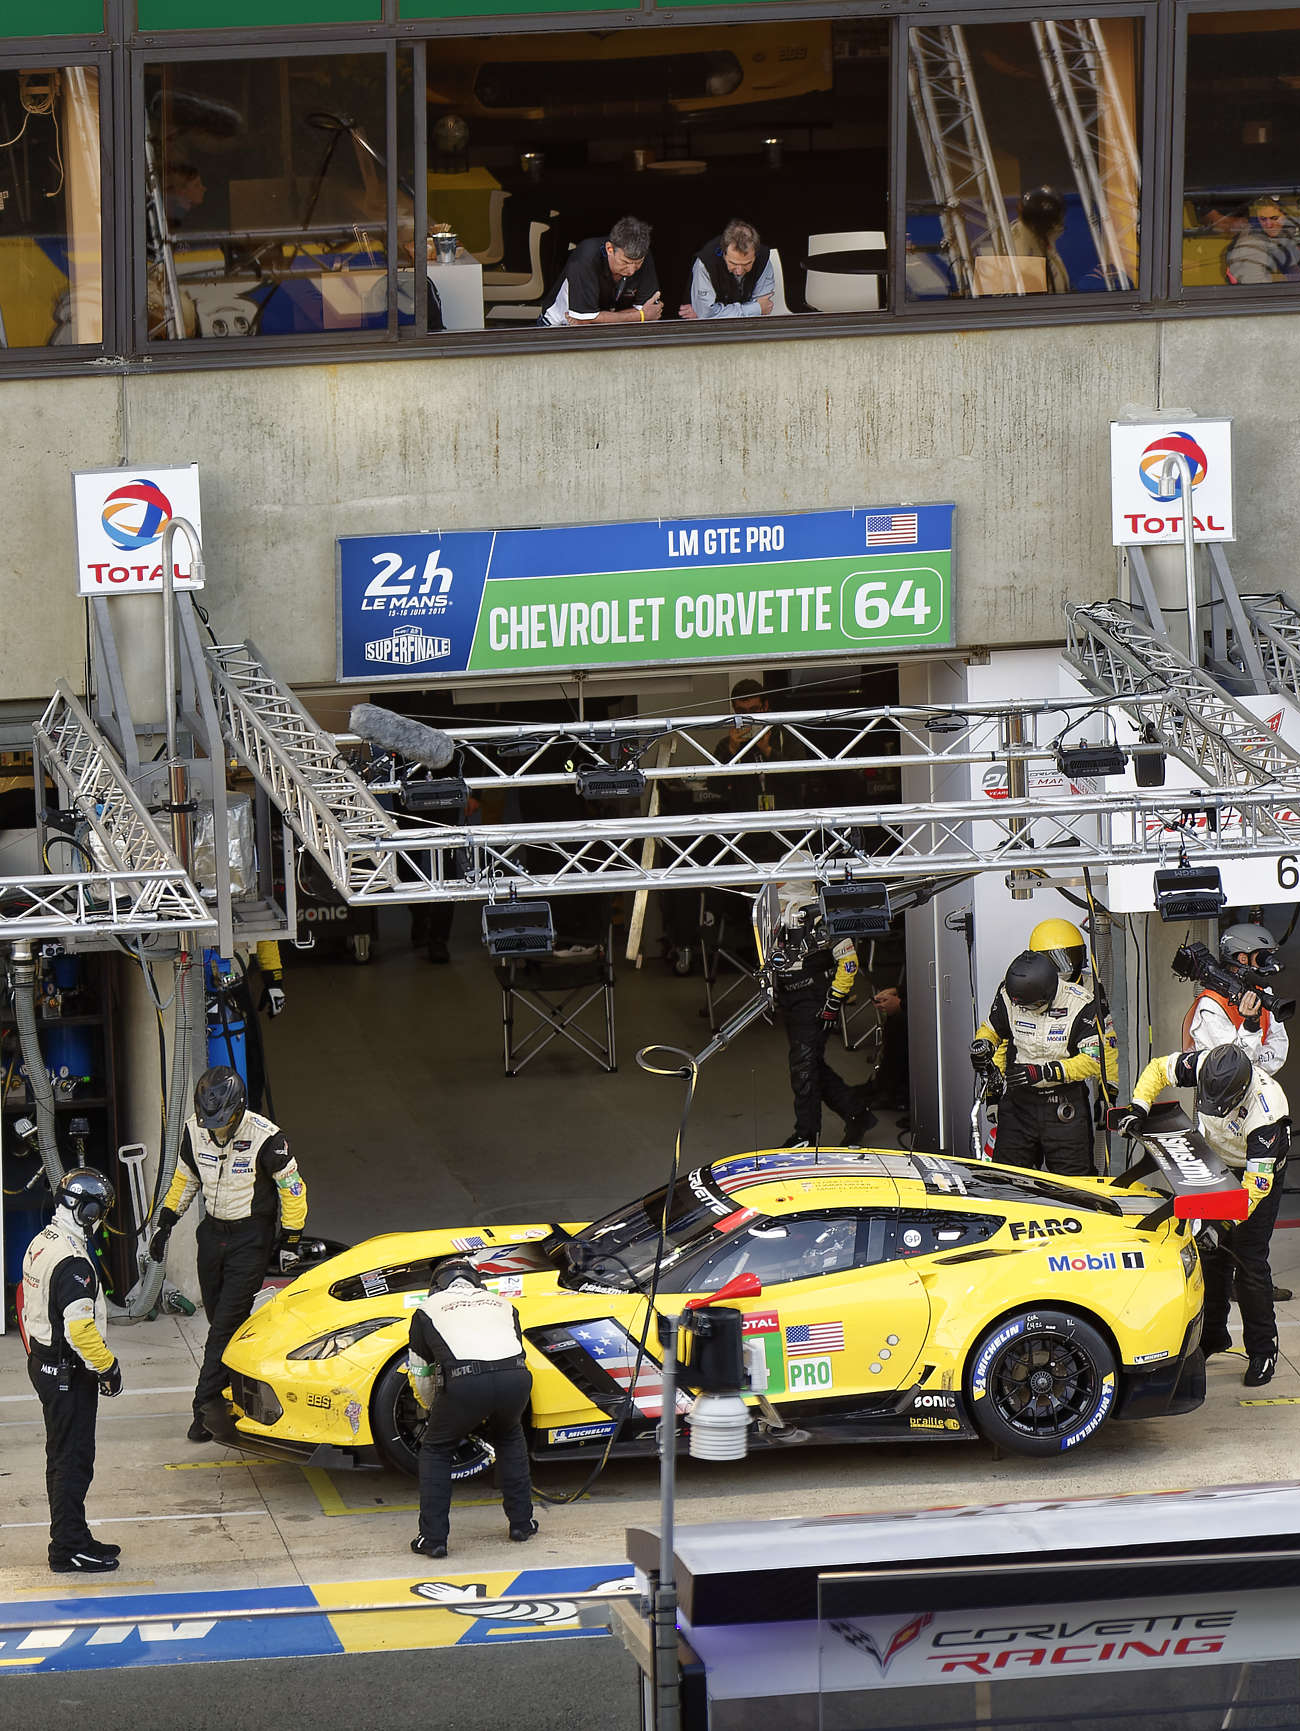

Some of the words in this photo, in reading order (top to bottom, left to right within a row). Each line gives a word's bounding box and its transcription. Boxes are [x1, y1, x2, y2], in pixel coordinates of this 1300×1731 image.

[668, 530, 698, 557] LM
[704, 528, 740, 554] GTE
[746, 526, 785, 552] PRO
[364, 550, 453, 596] 24h
[361, 597, 387, 611] LE
[389, 595, 448, 609] MANS
[428, 607, 446, 615] 2019
[489, 598, 662, 652] CHEVROLET
[675, 586, 831, 639] CORVETTE
[854, 580, 931, 628] 64
[367, 636, 449, 663] SUPERFINALE
[1009, 1217, 1082, 1240] FARO
[1049, 1253, 1117, 1272] Mobil
[1126, 1252, 1143, 1269] 1
[742, 1318, 777, 1330] OTAL
[976, 1324, 1020, 1376] MICHELIN
[791, 1360, 831, 1389] PRO
[307, 1394, 331, 1409] BBS
[568, 1427, 612, 1438] MICHELIN
[1066, 1396, 1111, 1447] MICHELIN
[931, 1610, 1238, 1649] CORVETTE
[925, 1635, 1227, 1675] RACING
